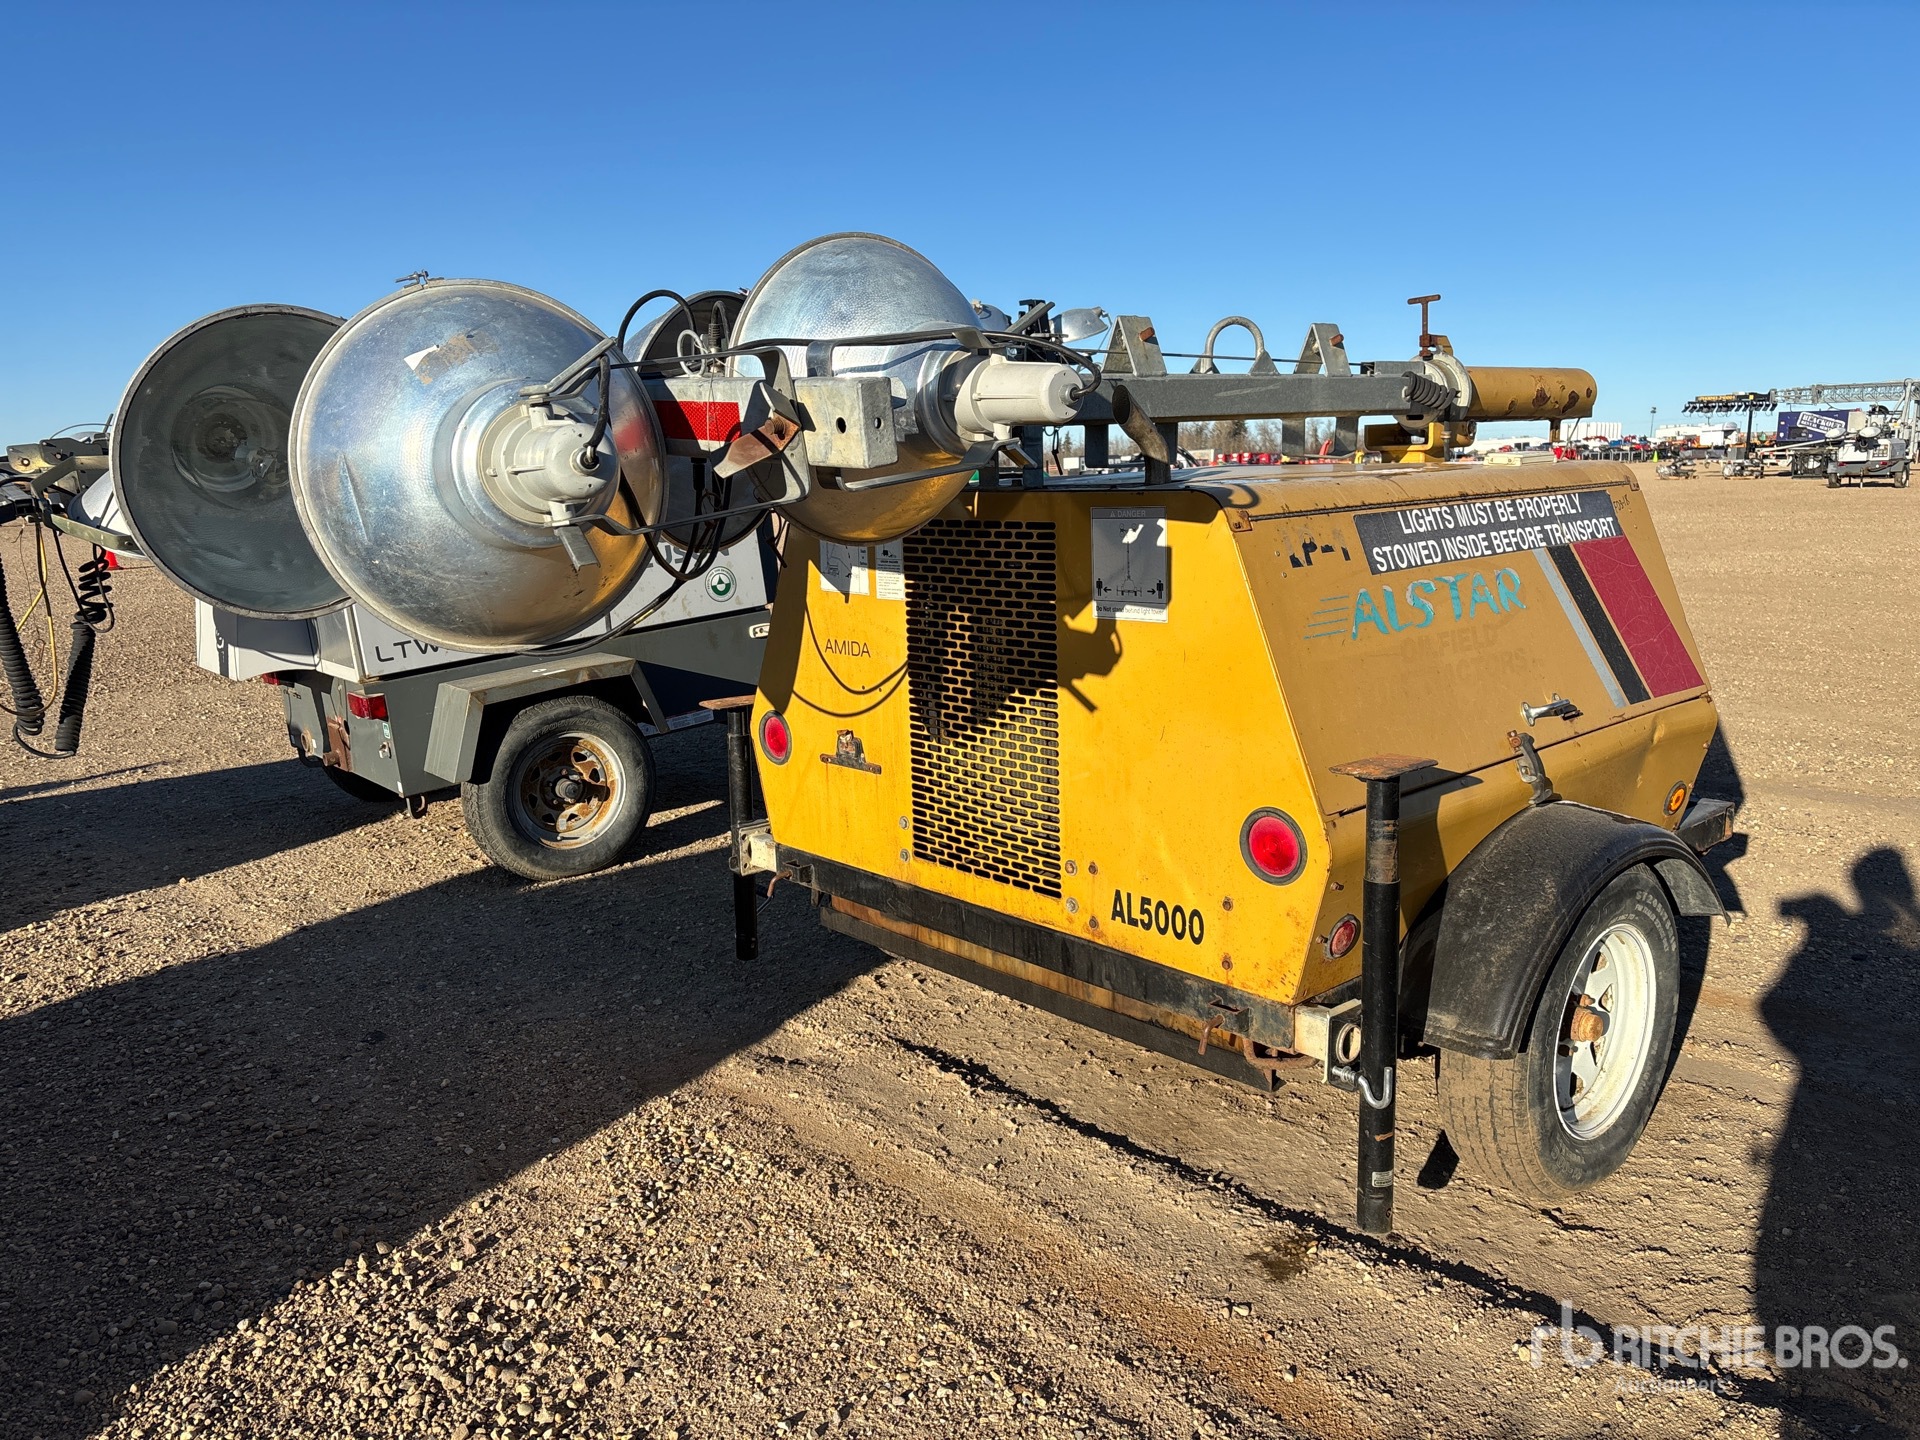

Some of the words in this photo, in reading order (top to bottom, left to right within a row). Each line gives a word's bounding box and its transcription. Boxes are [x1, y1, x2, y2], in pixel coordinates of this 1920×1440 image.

[1117, 509, 1147, 518] DANGER
[1397, 506, 1455, 535] LIGHTS
[1454, 502, 1496, 528] MUST
[1494, 500, 1518, 523] BE
[1517, 492, 1584, 521] PROPERLY
[1372, 541, 1443, 572] STOWED
[1441, 532, 1492, 560] INSIDE
[1490, 525, 1547, 553] BEFORE
[1544, 516, 1617, 547] TRANSPORT
[1352, 567, 1527, 641] ALSTAR
[825, 638, 872, 658] AMIDA
[1111, 889, 1205, 945] AL5000
